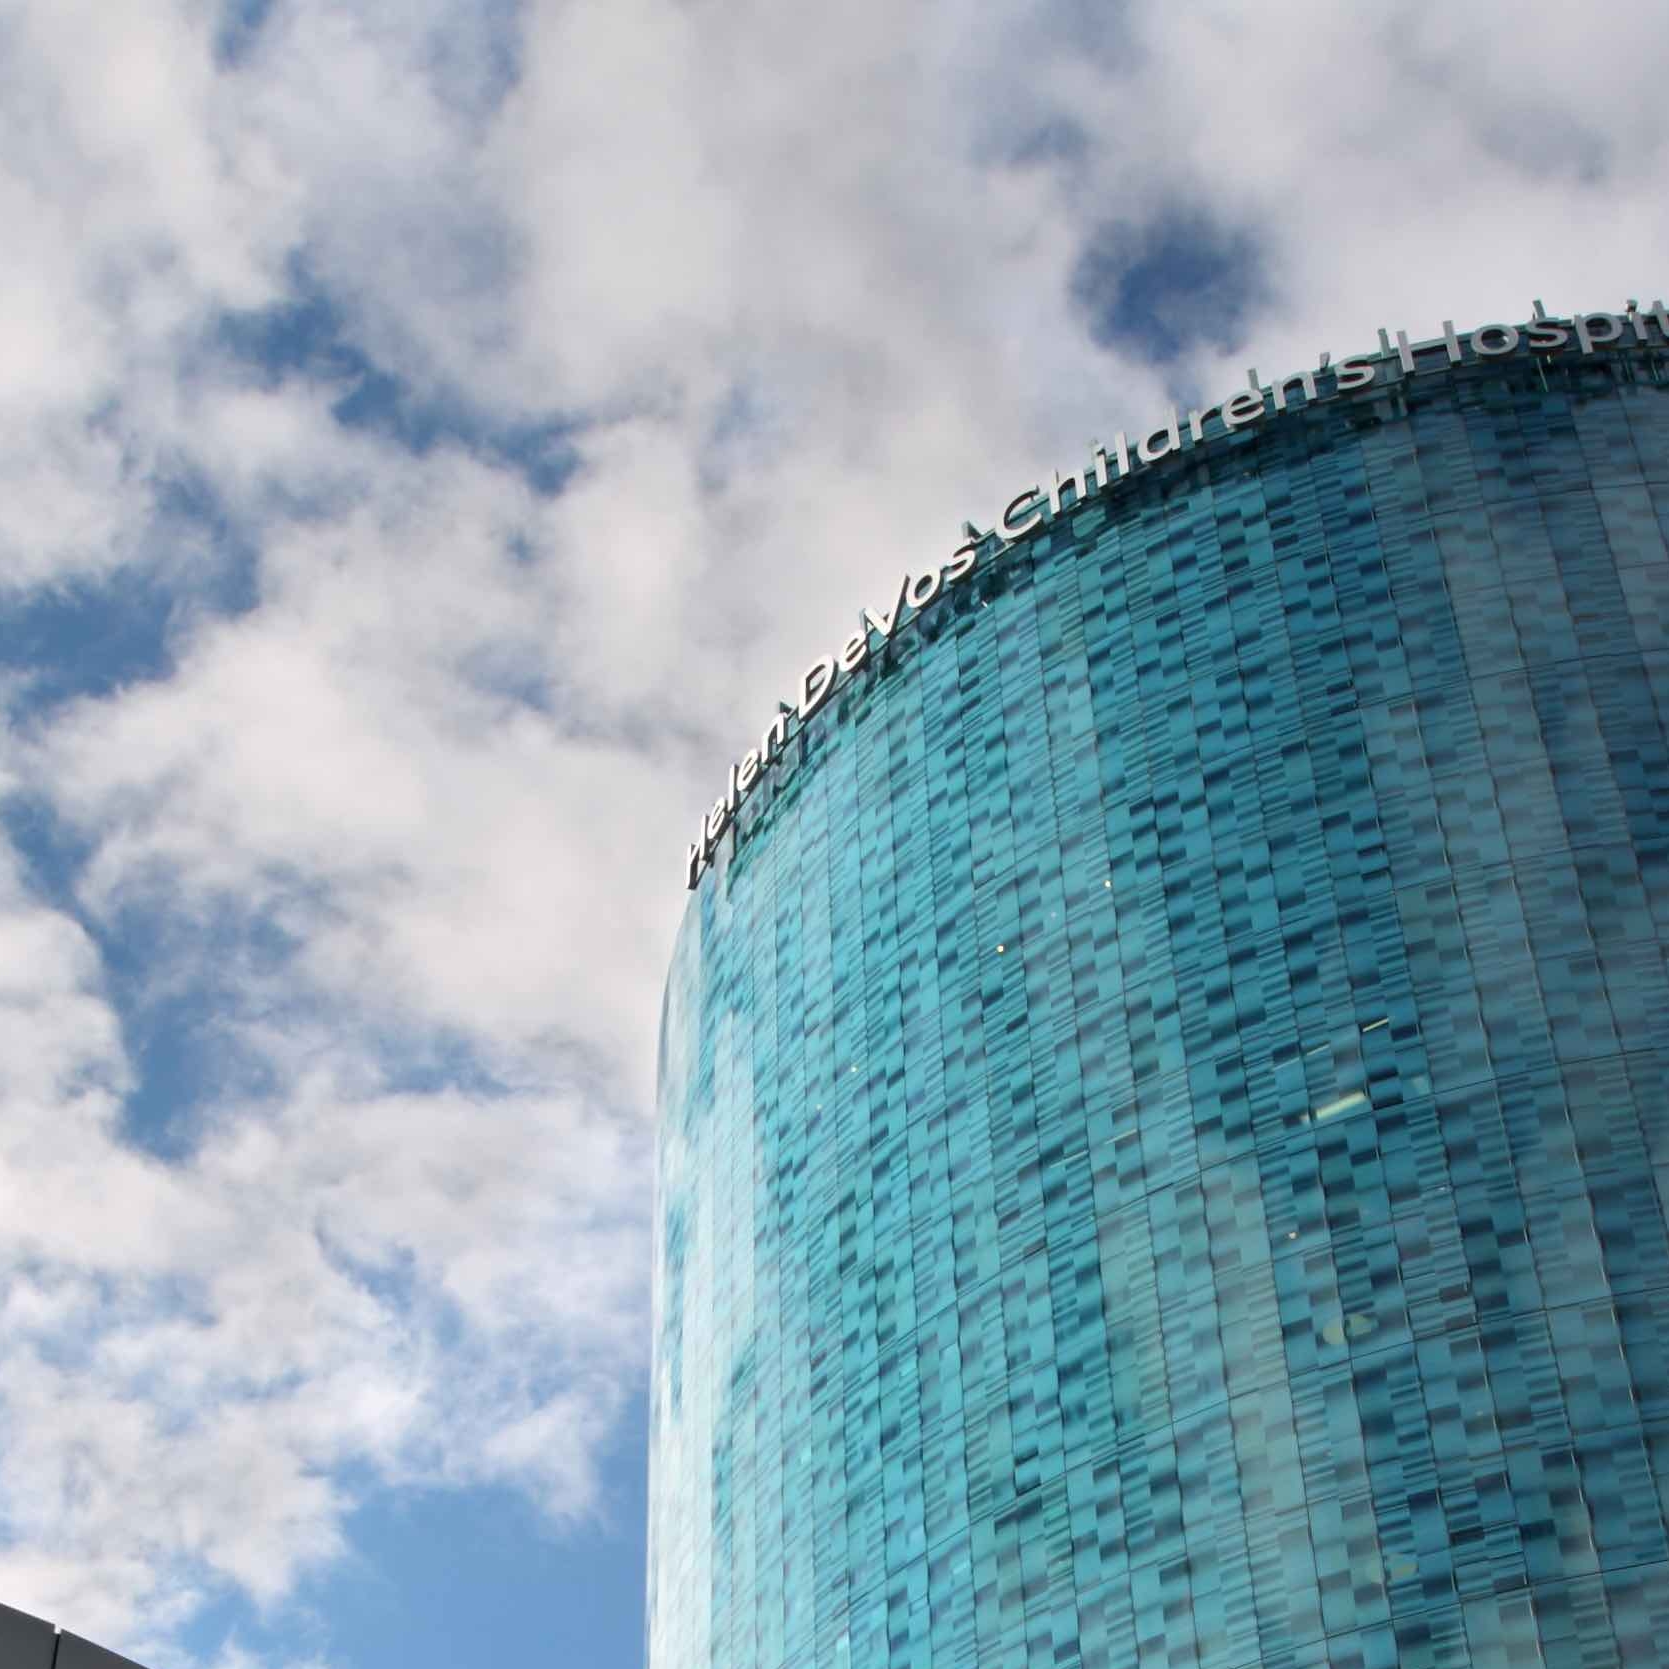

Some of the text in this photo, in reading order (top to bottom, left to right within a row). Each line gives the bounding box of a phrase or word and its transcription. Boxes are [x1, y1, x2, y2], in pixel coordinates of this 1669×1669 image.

[686, 711, 788, 889] Helen
[797, 537, 978, 720] DeVos
[995, 351, 1376, 541] Children's
